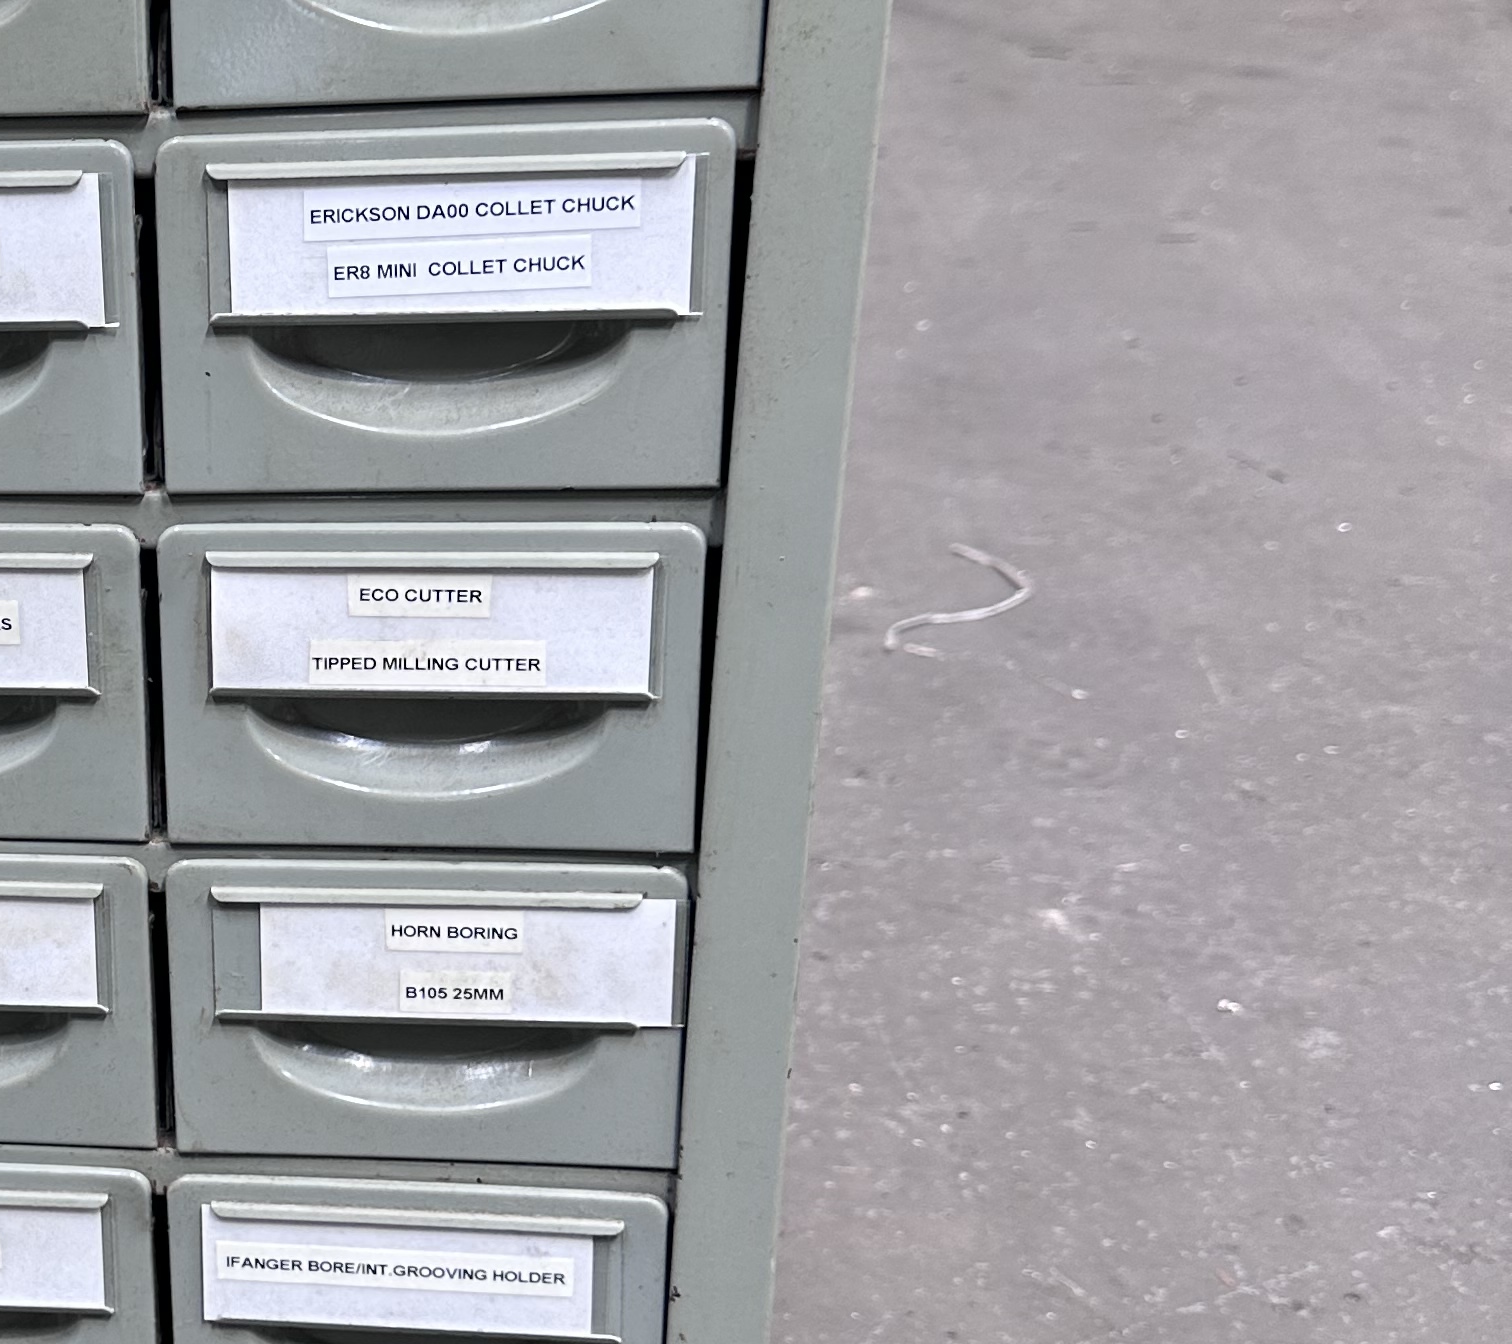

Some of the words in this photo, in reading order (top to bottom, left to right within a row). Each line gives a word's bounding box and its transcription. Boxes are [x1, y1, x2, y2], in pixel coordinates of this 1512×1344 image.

[310, 206, 411, 225] ERICKSON
[474, 199, 557, 218] COLLET
[561, 194, 636, 214] CHUCK
[333, 264, 371, 281] ER8
[376, 262, 417, 280] MINI
[428, 258, 508, 277] COLLET
[512, 254, 586, 274] CHUCK
[359, 587, 399, 603] ECO
[404, 588, 483, 604] CUTTER
[311, 656, 377, 671] TIPPED
[382, 657, 459, 671] MILLING
[464, 657, 542, 672] CUTTER
[391, 924, 441, 938] HORN
[447, 926, 518, 940] BORING
[405, 986, 448, 1000] B105
[452, 987, 504, 1001] 25MM
[225, 1255, 304, 1272] IFANGER
[492, 1269, 566, 1286] HOLDER
